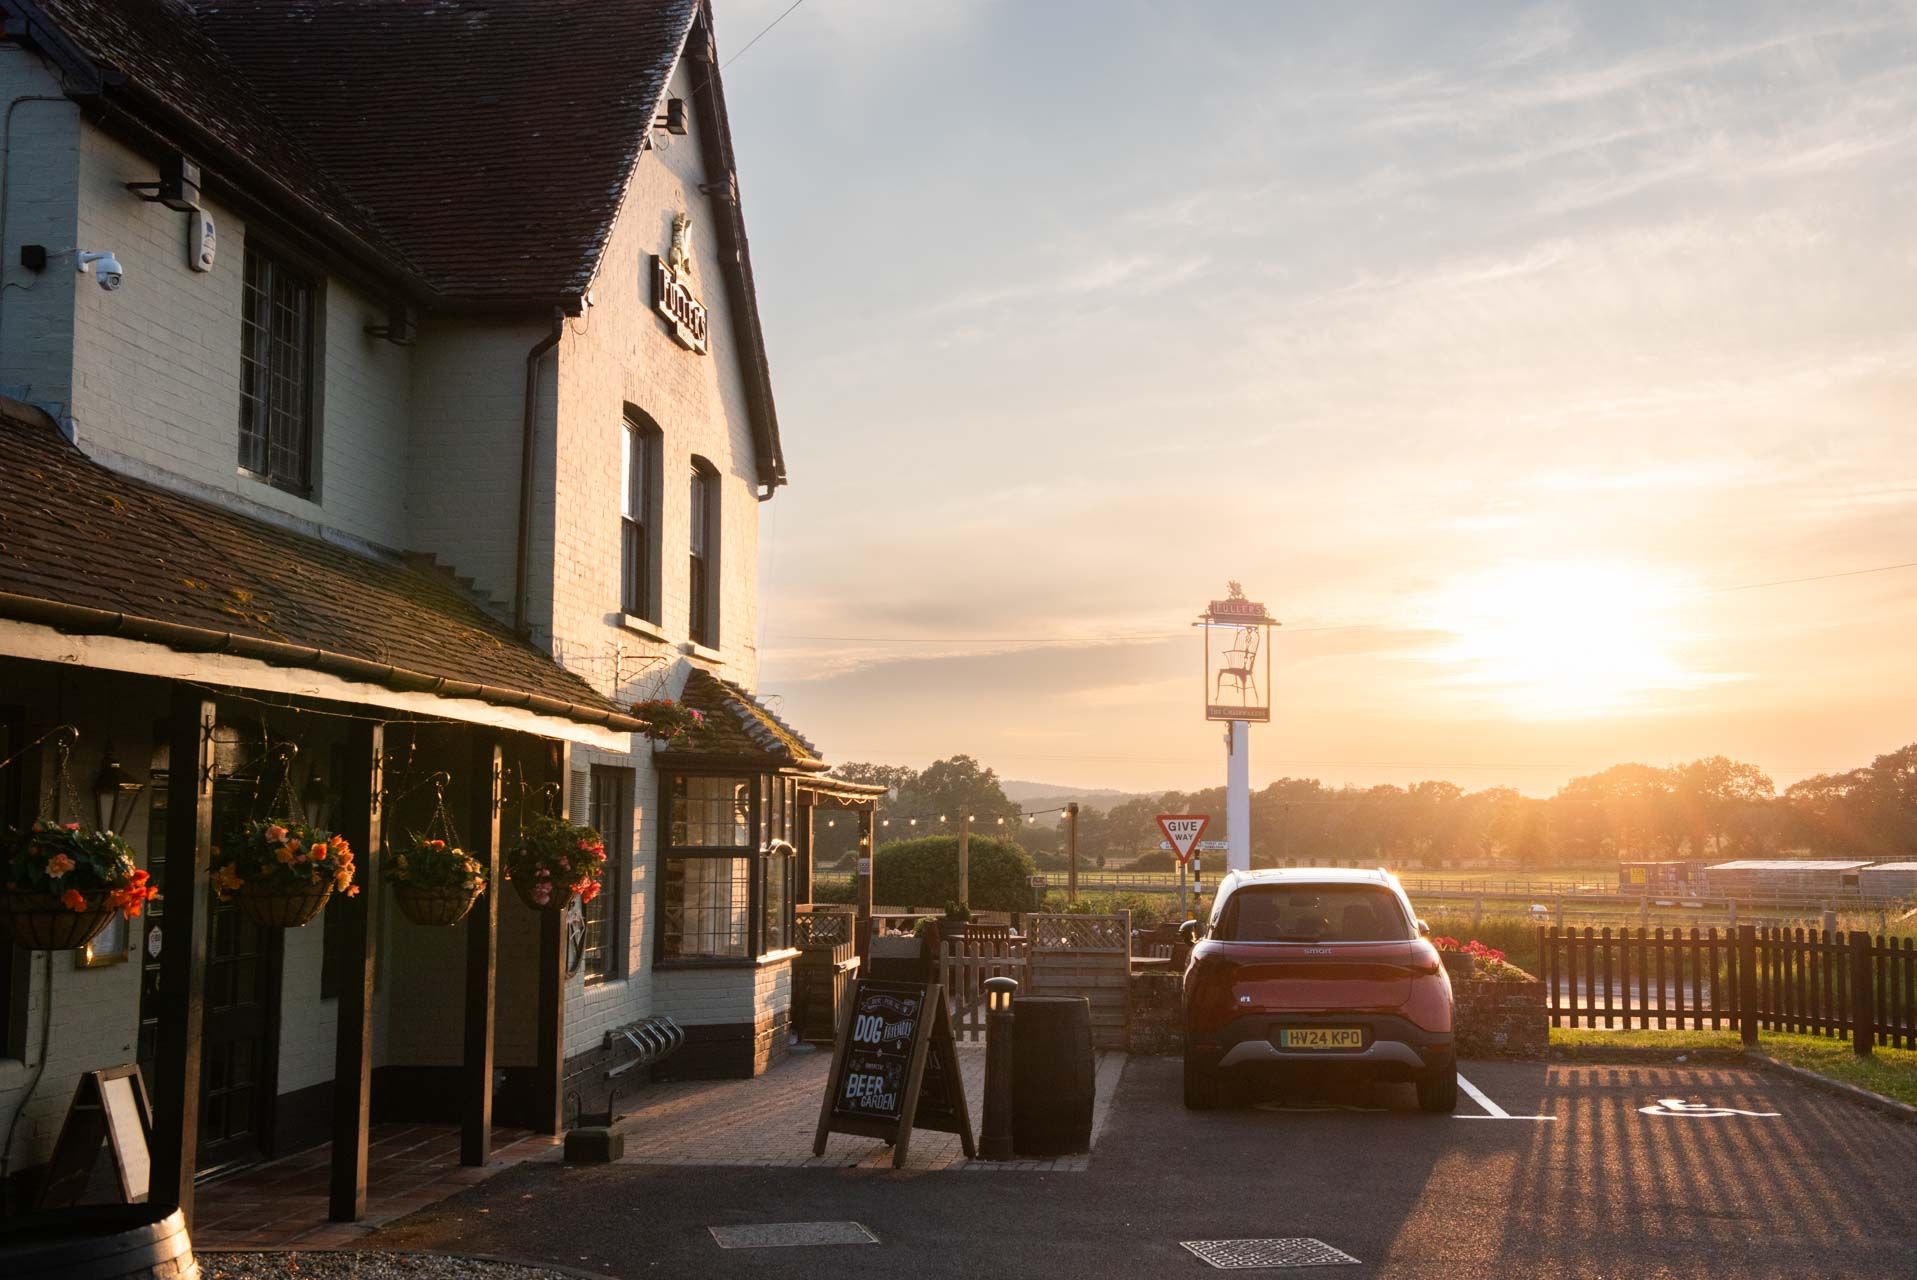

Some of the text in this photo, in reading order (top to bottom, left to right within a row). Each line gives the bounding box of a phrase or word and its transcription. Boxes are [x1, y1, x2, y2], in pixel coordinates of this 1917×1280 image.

[1168, 821, 1197, 831] GIVE
[854, 1014, 883, 1044] DOG
[1290, 1031, 1329, 1045] HV24
[846, 1073, 884, 1098] BEER
[861, 1092, 897, 1111] GARDEN
